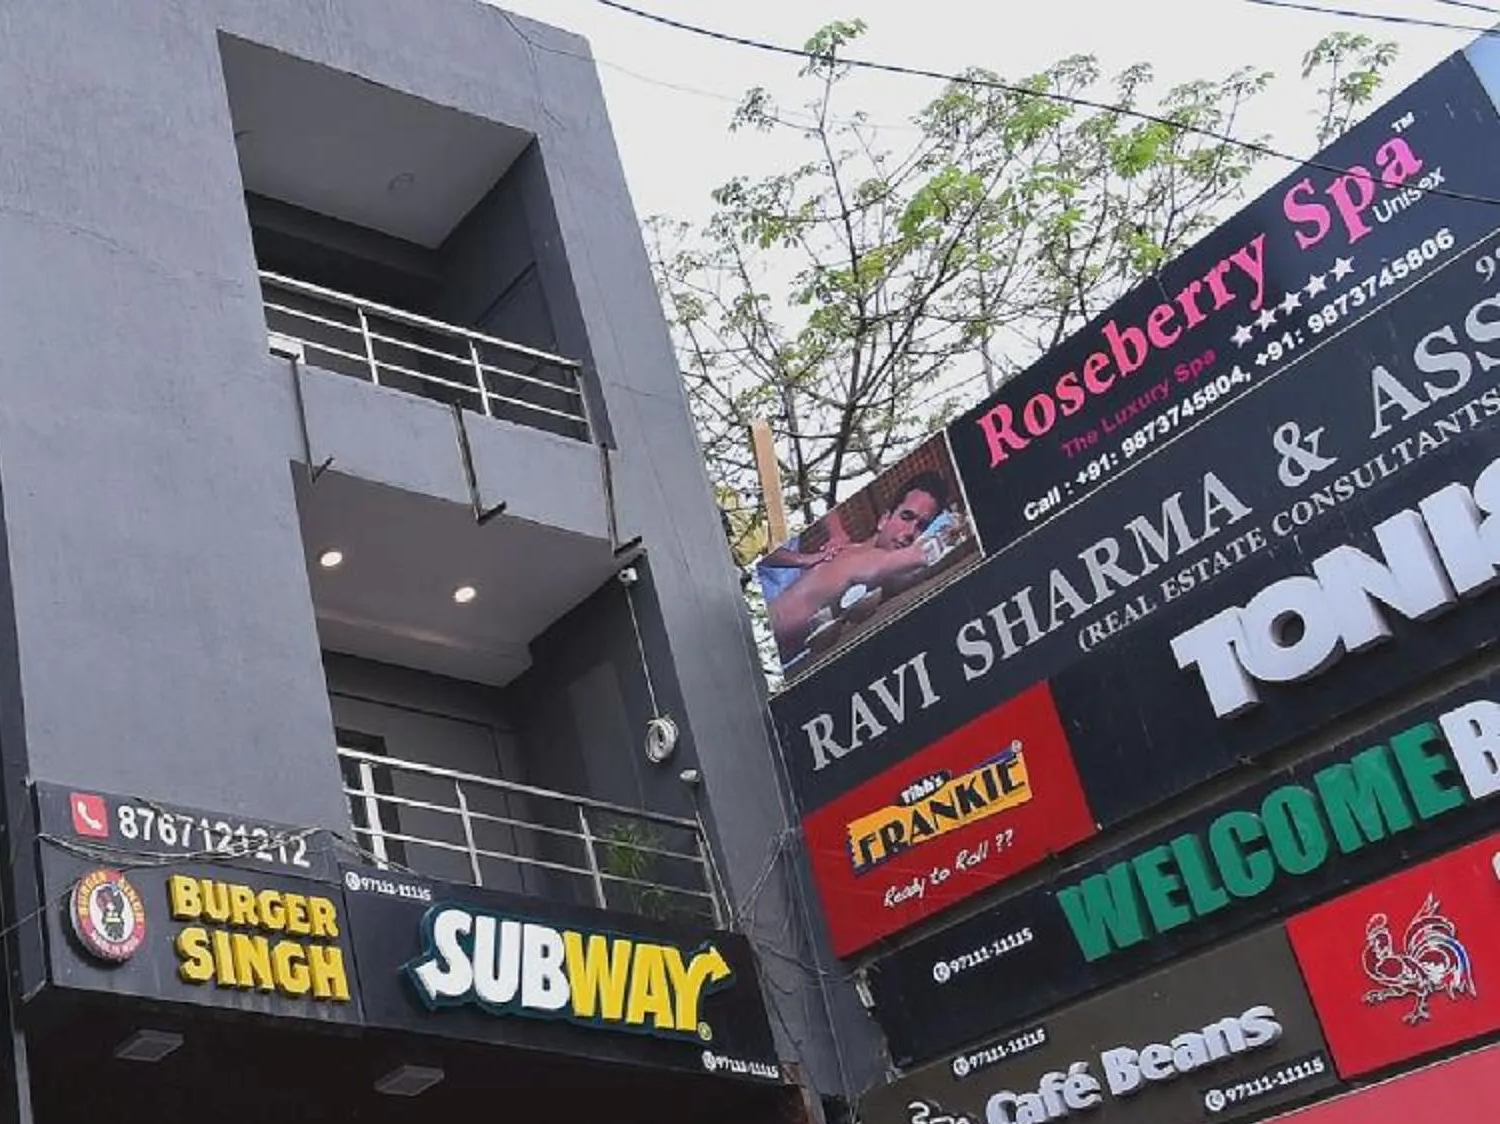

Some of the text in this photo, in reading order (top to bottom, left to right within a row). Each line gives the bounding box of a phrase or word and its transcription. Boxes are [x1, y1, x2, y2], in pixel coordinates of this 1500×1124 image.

[1372, 166, 1446, 223] Unisex
[976, 136, 1424, 468] Roseberry Spa
[1023, 491, 1061, 522] Call
[1307, 228, 1456, 334] 9873745806
[1061, 349, 1217, 458] The Luxury Spa
[1078, 387, 1500, 652] (REAL ESTATE CONSULTANTS
[801, 652, 941, 771] RAVI
[956, 471, 1252, 681] SHARMA
[1272, 420, 1339, 487] &
[855, 758, 1026, 866] FRANKIE
[168, 874, 339, 937] BURGER
[883, 876, 926, 908] Ready
[930, 865, 950, 885] to
[955, 841, 989, 871] Roll
[176, 926, 351, 1001] SINGH
[416, 909, 732, 1032] SUBWAY
[1101, 1005, 1283, 1097] Beans
